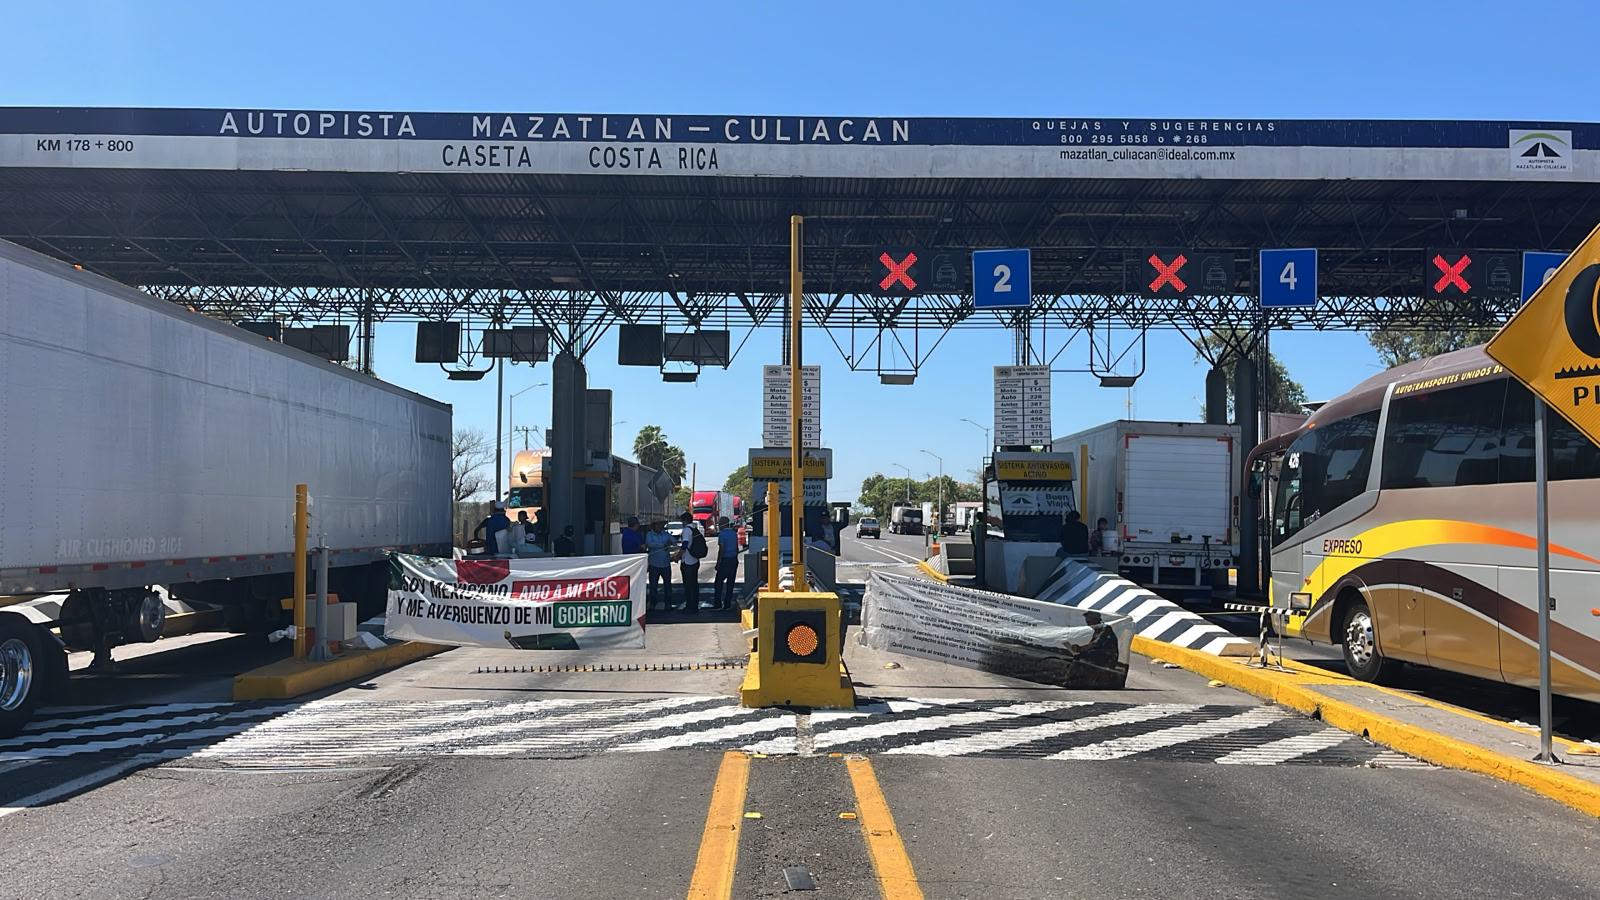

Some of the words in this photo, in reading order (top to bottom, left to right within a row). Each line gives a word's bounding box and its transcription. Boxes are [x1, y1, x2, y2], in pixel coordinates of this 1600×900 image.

[219, 112, 417, 137] AUTOPISTA
[471, 116, 672, 140] MAZATLAN
[724, 118, 909, 142] CULIACAN
[1032, 121, 1102, 131] QUEJAS
[1122, 121, 1130, 130] Y
[1149, 122, 1276, 131] SUGERENCIAS
[37, 140, 62, 152] KM
[65, 139, 91, 152] 178
[107, 140, 134, 152] 800
[1060, 134, 1083, 144] 800
[1091, 134, 1114, 144] 295
[1119, 134, 1149, 144] 5858
[442, 144, 532, 168] CASETA
[589, 146, 662, 169] COSTA
[678, 146, 719, 170] RICA
[1060, 148, 1237, 162] mazatlan_culiacan@ideal.com.mx
[992, 264, 1012, 292] 2
[1279, 262, 1298, 290] 4
[1394, 374, 1459, 394] AUTOTRANSPORTES
[1460, 367, 1491, 380] UNIDOS
[1046, 500, 1070, 508] Viaje
[57, 538, 80, 558] AIR
[87, 537, 156, 556] CUSHIONED
[1323, 539, 1362, 554] EXPRESO
[402, 574, 426, 594] SOY
[520, 584, 550, 600] AMO
[553, 583, 562, 600] A
[564, 582, 582, 598] MI
[397, 597, 405, 615] Y
[406, 599, 426, 618] ME
[426, 603, 510, 625] AVERGUENZO
[514, 606, 532, 625] DE
[536, 607, 552, 626] MI
[558, 604, 628, 626] GOBIERNO
